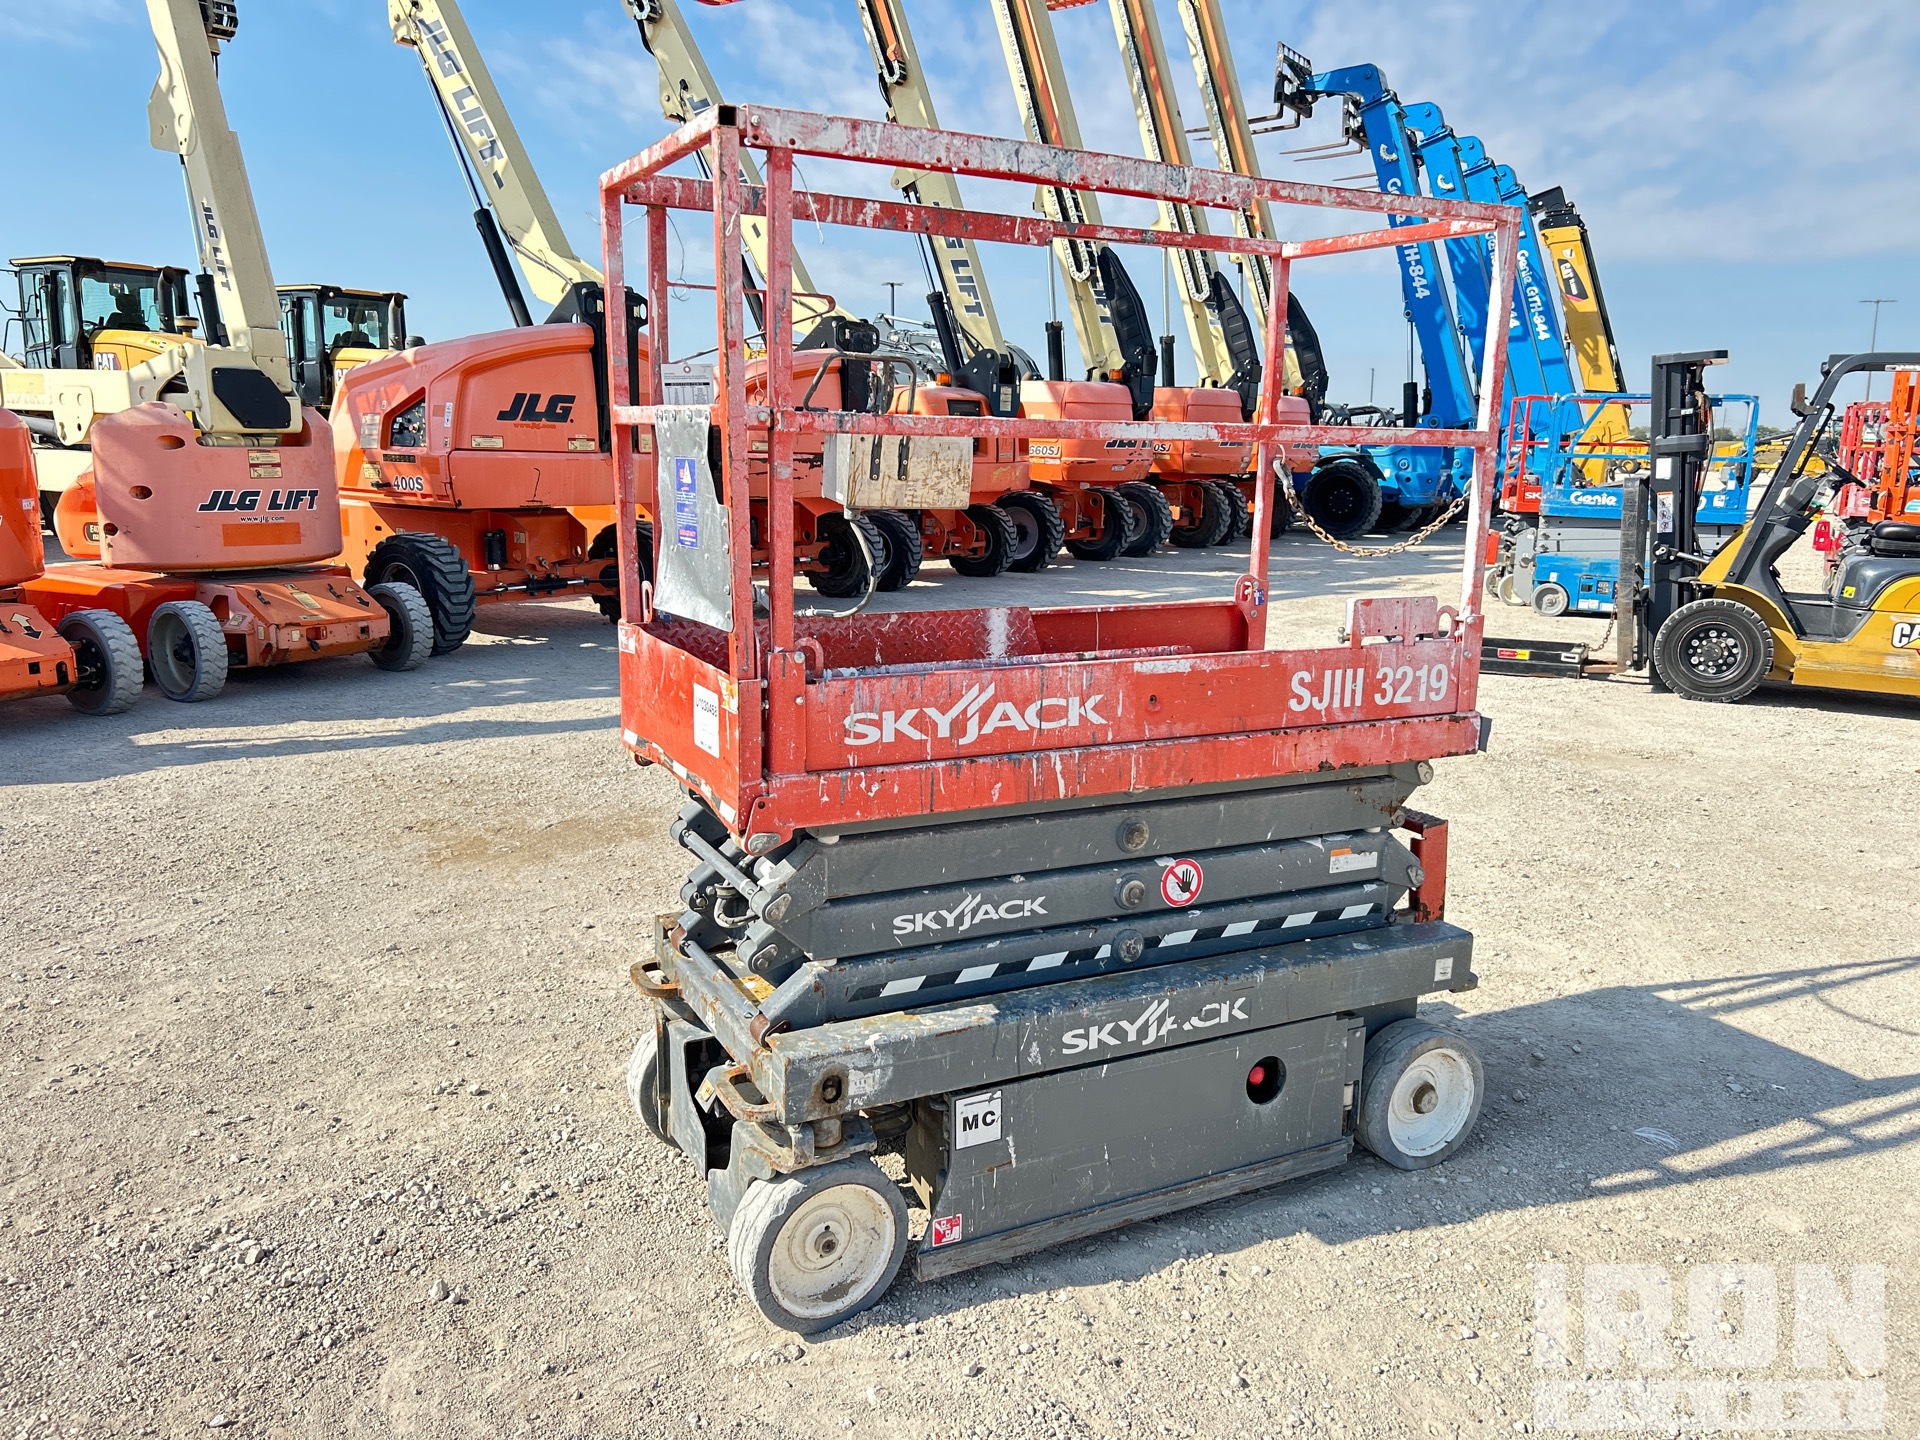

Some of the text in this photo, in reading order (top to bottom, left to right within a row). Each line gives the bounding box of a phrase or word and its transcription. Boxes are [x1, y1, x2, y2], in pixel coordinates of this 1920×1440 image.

[416, 18, 504, 162] JLG LIFT
[201, 202, 231, 291] JLG LIFT
[1517, 249, 1533, 286] Genie
[949, 259, 985, 318] LIFT
[1402, 243, 1431, 299] TH-844
[95, 353, 115, 370] CAT
[496, 393, 576, 423] JLG
[197, 488, 319, 512] JLG LIFT
[393, 476, 424, 492] 400S
[1570, 491, 1618, 506] Genie
[1374, 663, 1449, 706] 3219
[843, 681, 1109, 747] SKYJACK
[892, 893, 1048, 935] SKYJACK
[1061, 996, 1249, 1054] SKYJACK
